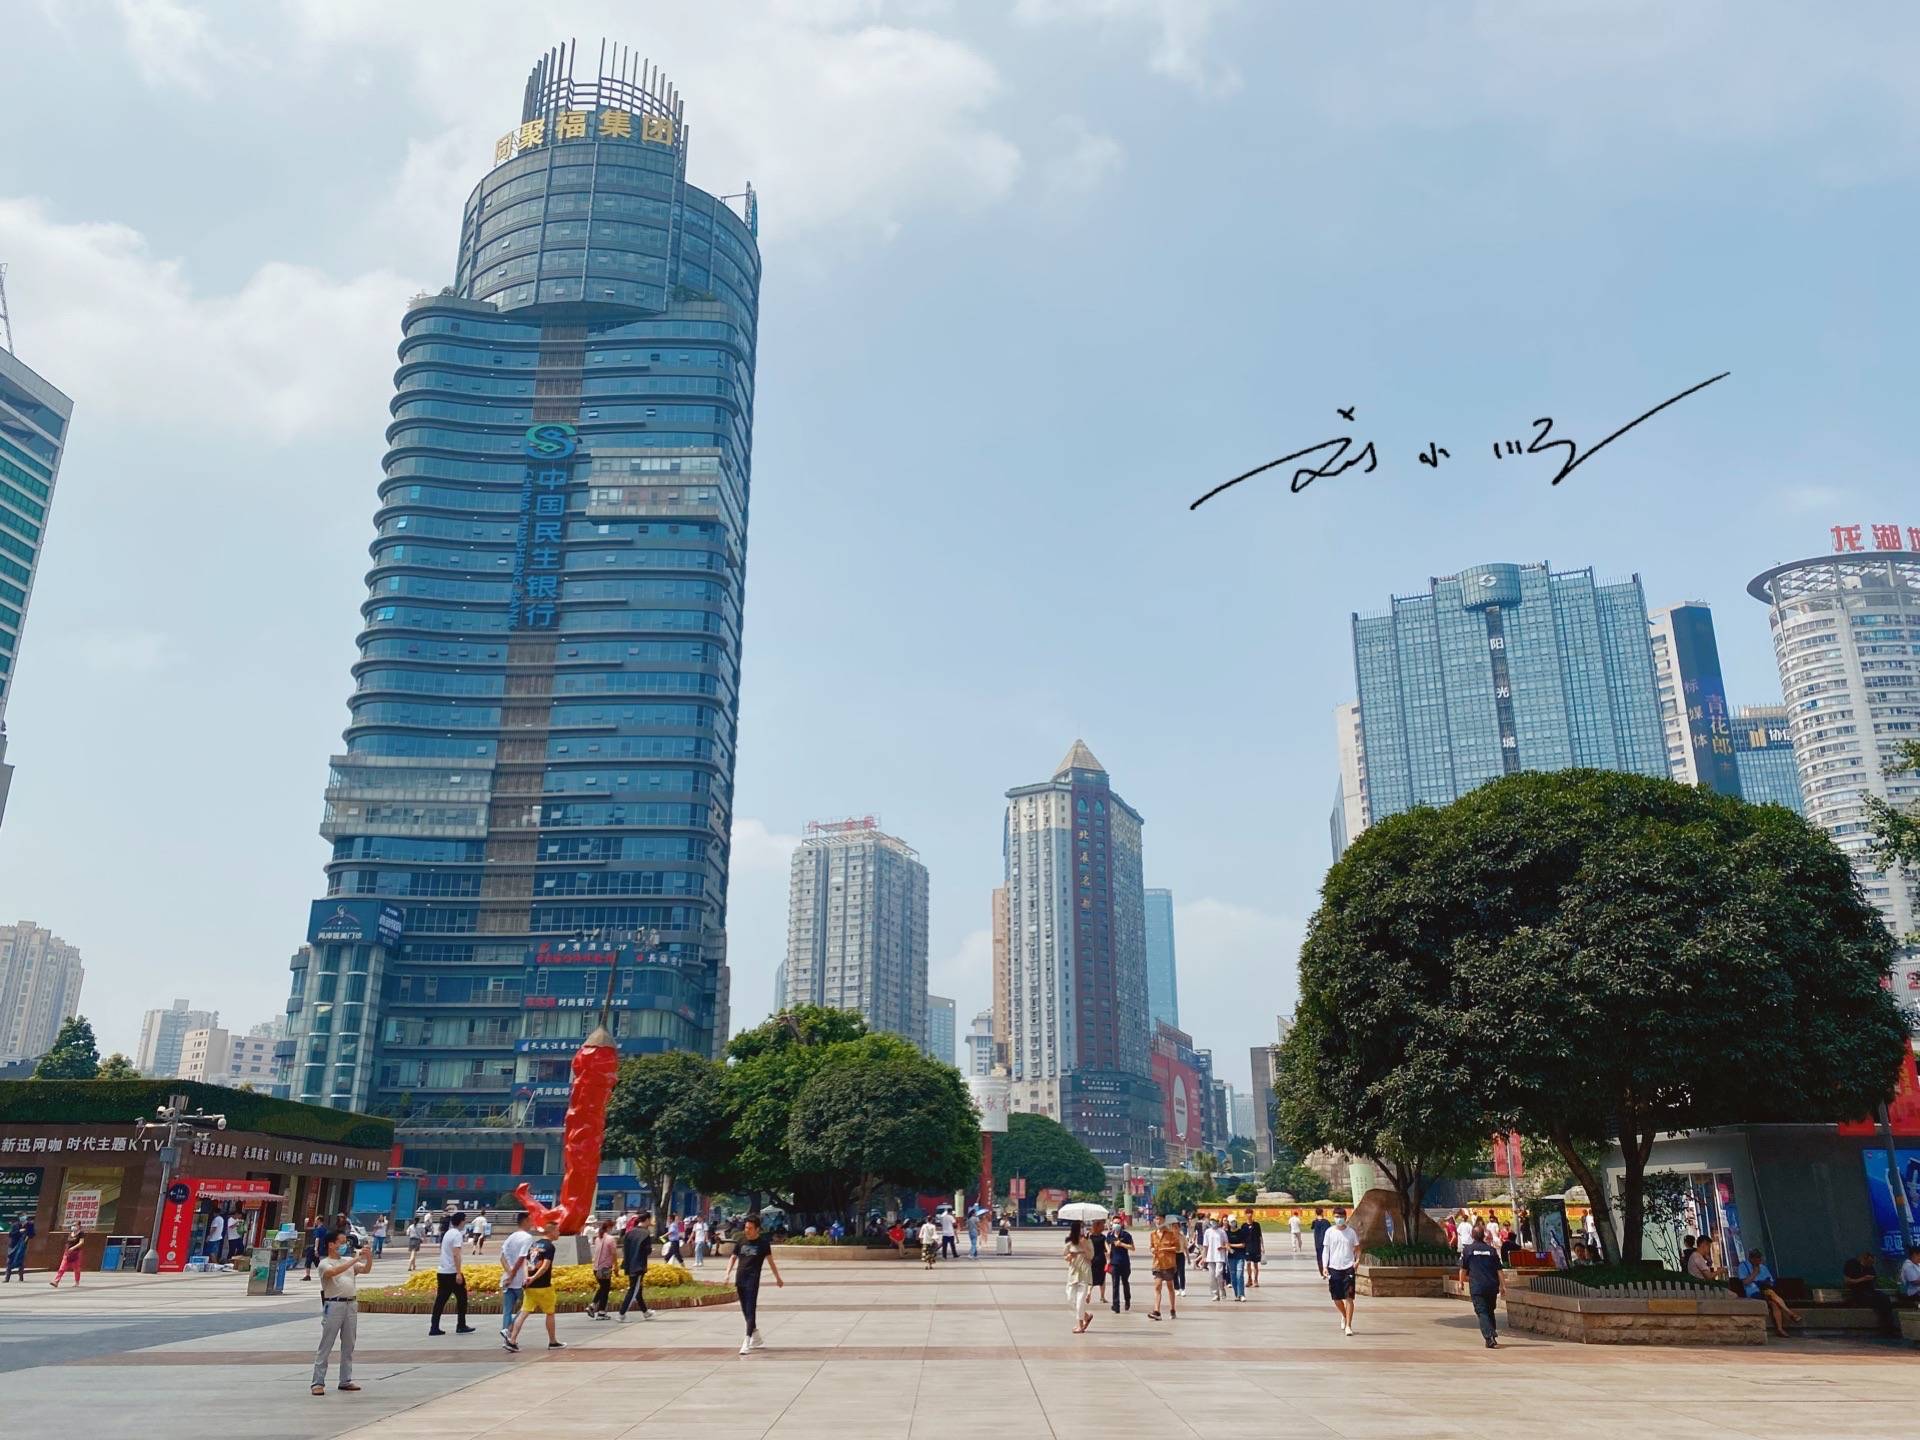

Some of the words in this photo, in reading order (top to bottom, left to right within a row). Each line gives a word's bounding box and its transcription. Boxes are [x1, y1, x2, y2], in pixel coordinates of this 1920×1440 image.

[519, 470, 535, 512] CHINA
[525, 468, 568, 627] 中国民生银行
[1489, 637, 1517, 748] 阳光城
[1705, 693, 1733, 755] 青花郎
[558, 998, 595, 1007] 时尚餐厅
[1, 1137, 63, 1152] 新迅网咖
